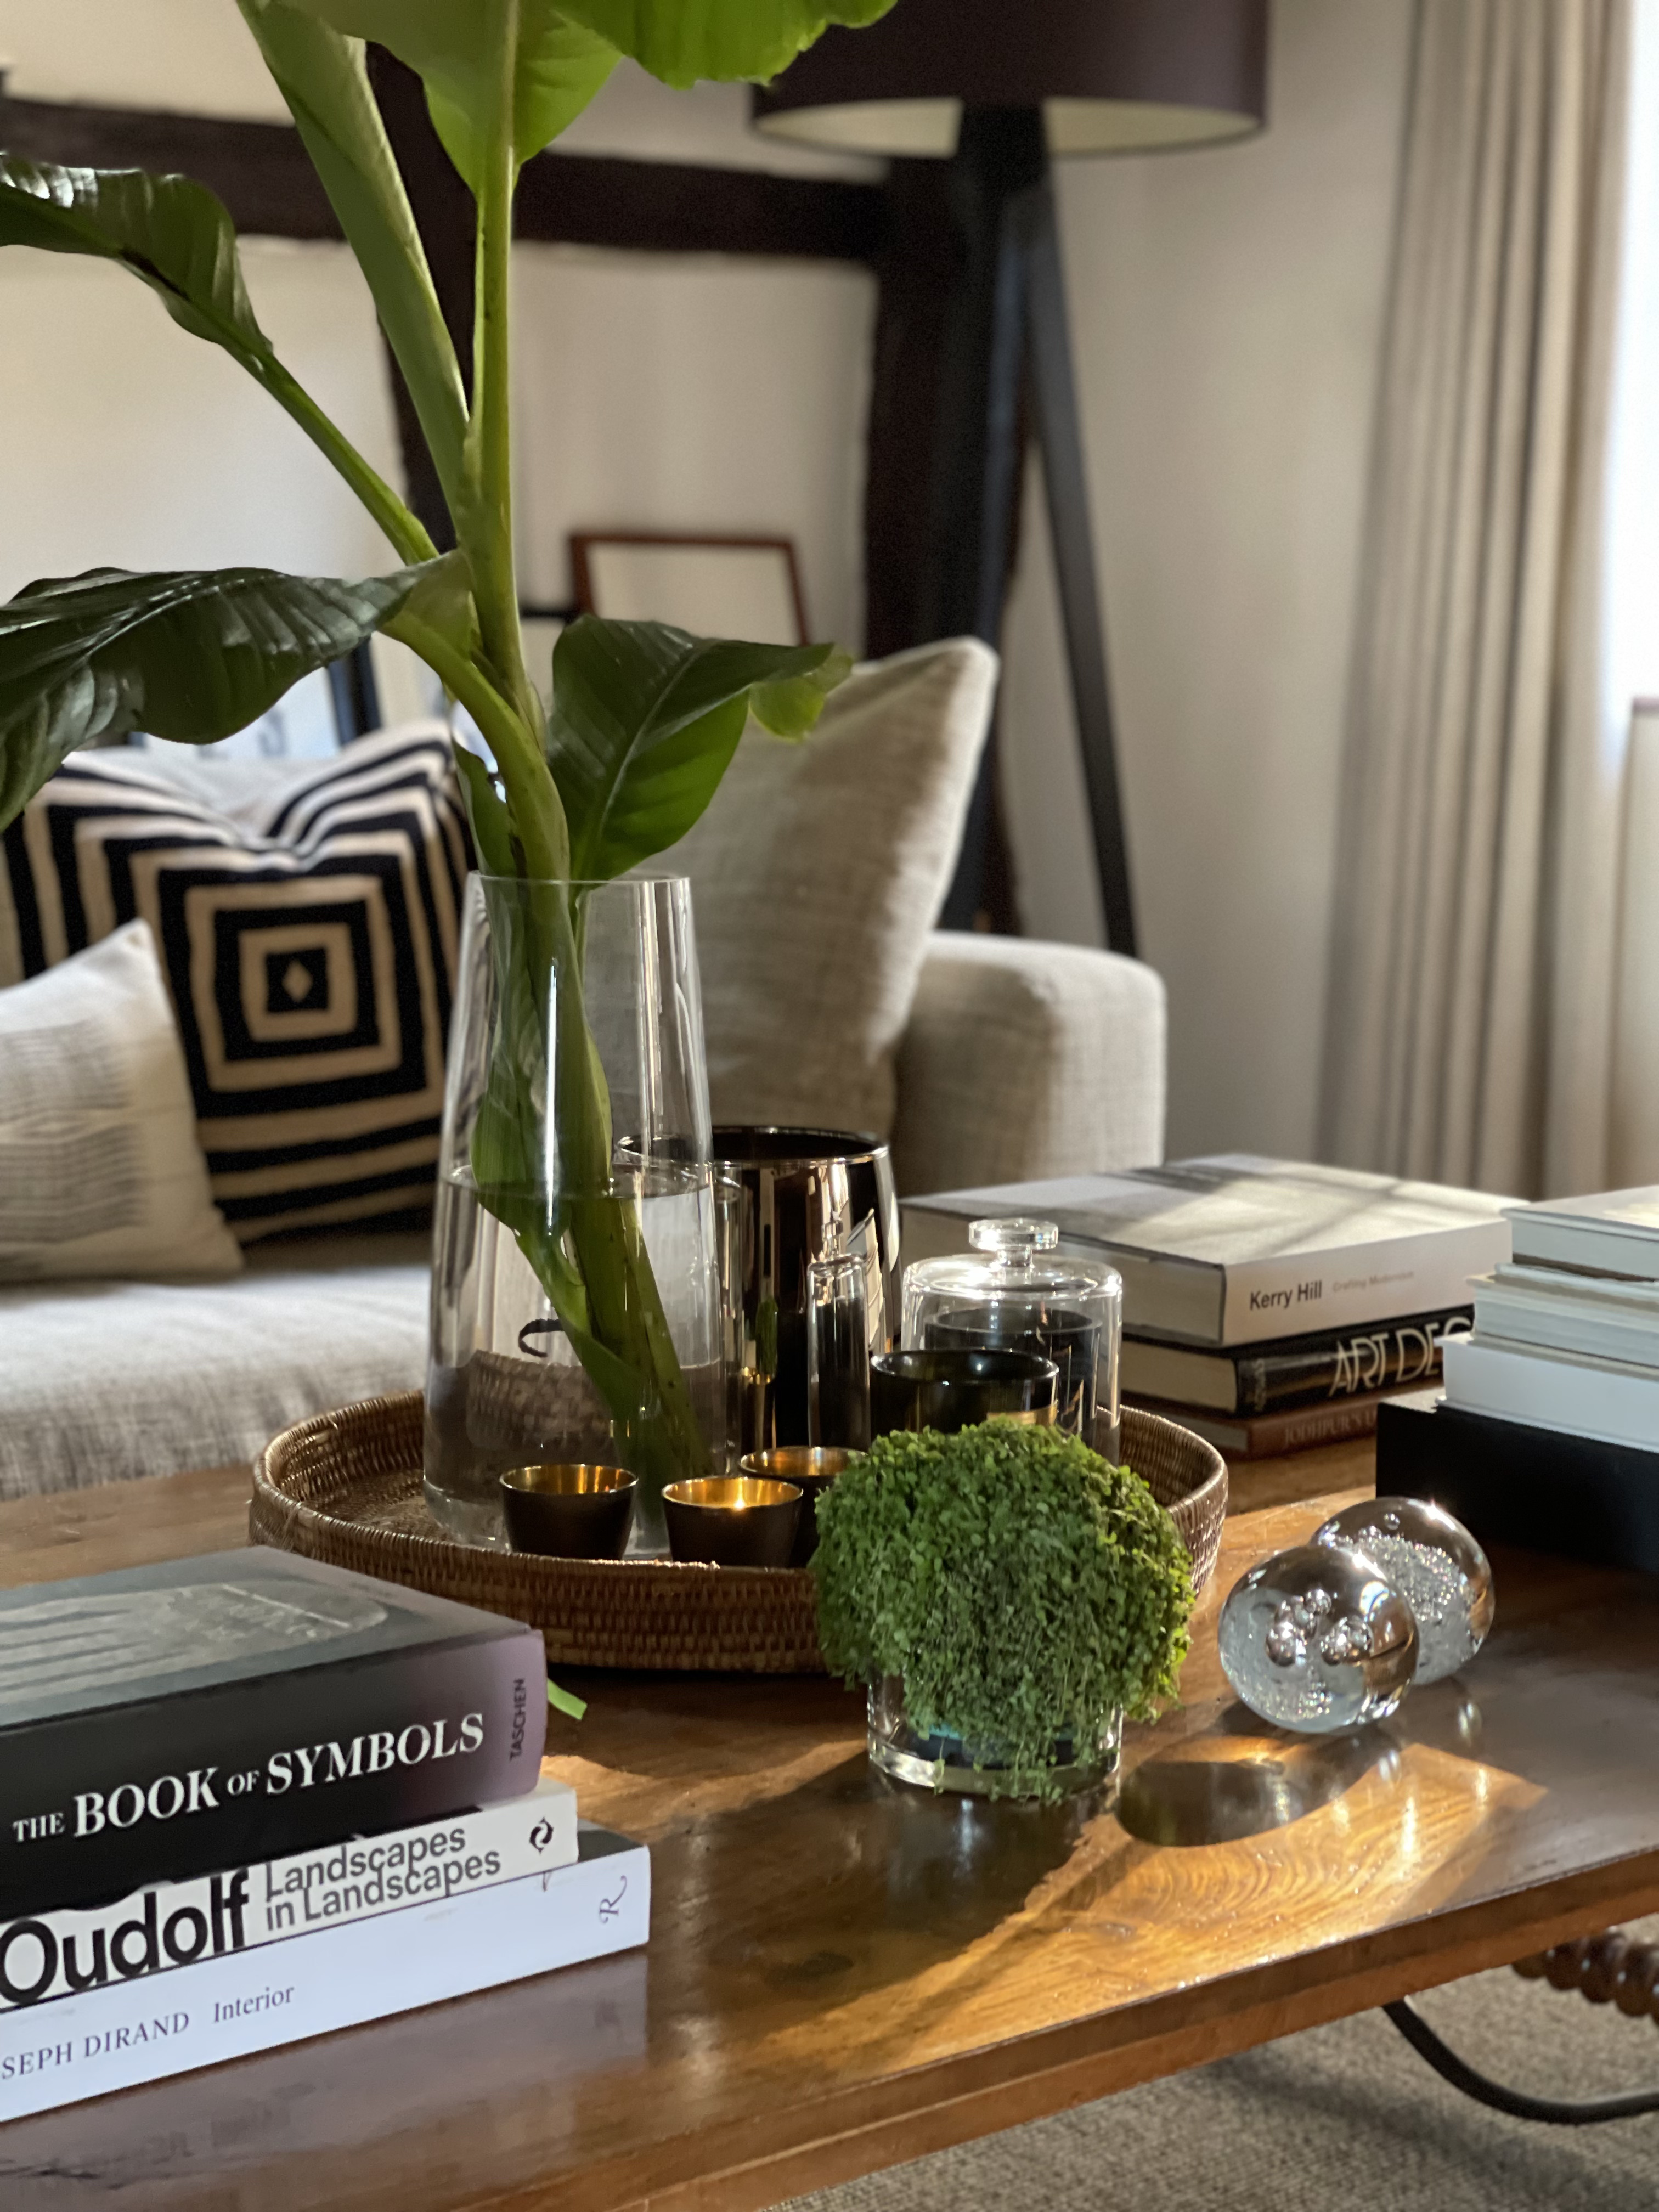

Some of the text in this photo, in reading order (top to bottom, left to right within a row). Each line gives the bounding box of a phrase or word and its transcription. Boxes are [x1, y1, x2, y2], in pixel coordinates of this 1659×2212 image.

[1250, 1289, 1293, 1310] Kerry
[1297, 1280, 1322, 1302] Hill
[1328, 1333, 1389, 1397] ART
[510, 1678, 526, 1762] TASCHEN
[13, 1713, 483, 1842] THE BOOK OF SYMBOLS
[266, 1828, 466, 1898] Landscapes
[266, 1850, 501, 1931] in Landscapes
[0, 1867, 249, 2005] Oudolf
[83, 2012, 190, 2057] DIRAND
[211, 1986, 295, 2023] Interior
